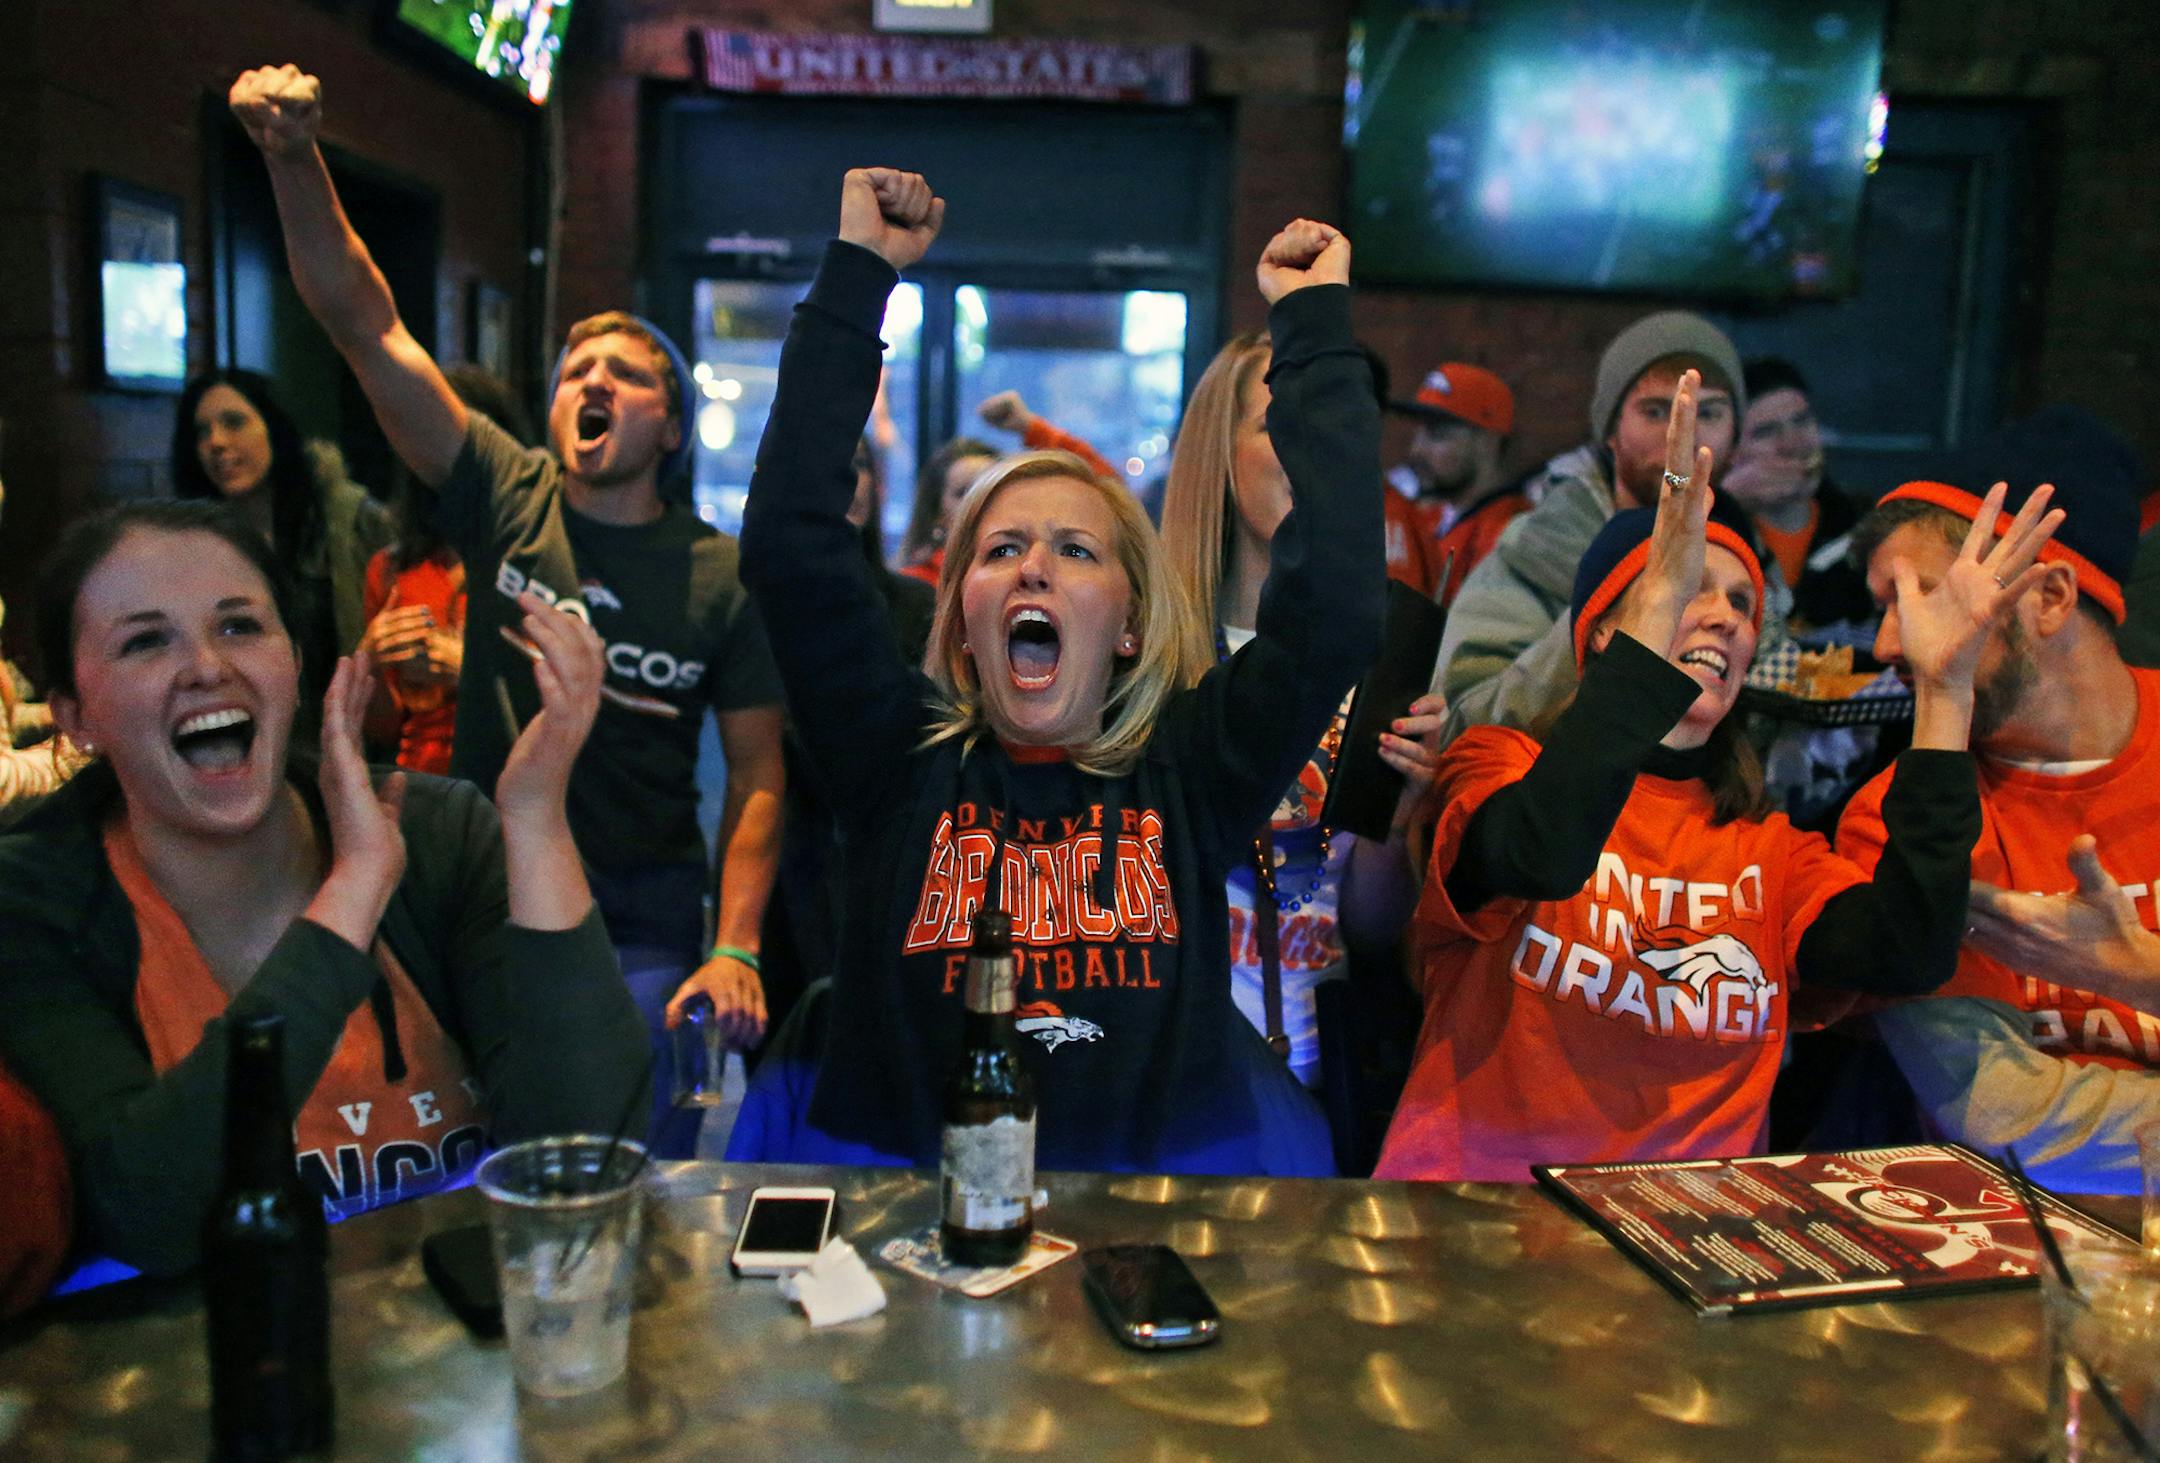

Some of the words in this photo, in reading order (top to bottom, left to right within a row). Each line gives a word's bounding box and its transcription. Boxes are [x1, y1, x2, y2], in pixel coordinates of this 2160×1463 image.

[495, 559, 706, 689] BROCOS
[902, 810, 1181, 956] BRONCOS
[1584, 851, 1766, 931] NITED
[942, 947, 1162, 994] FTBALL
